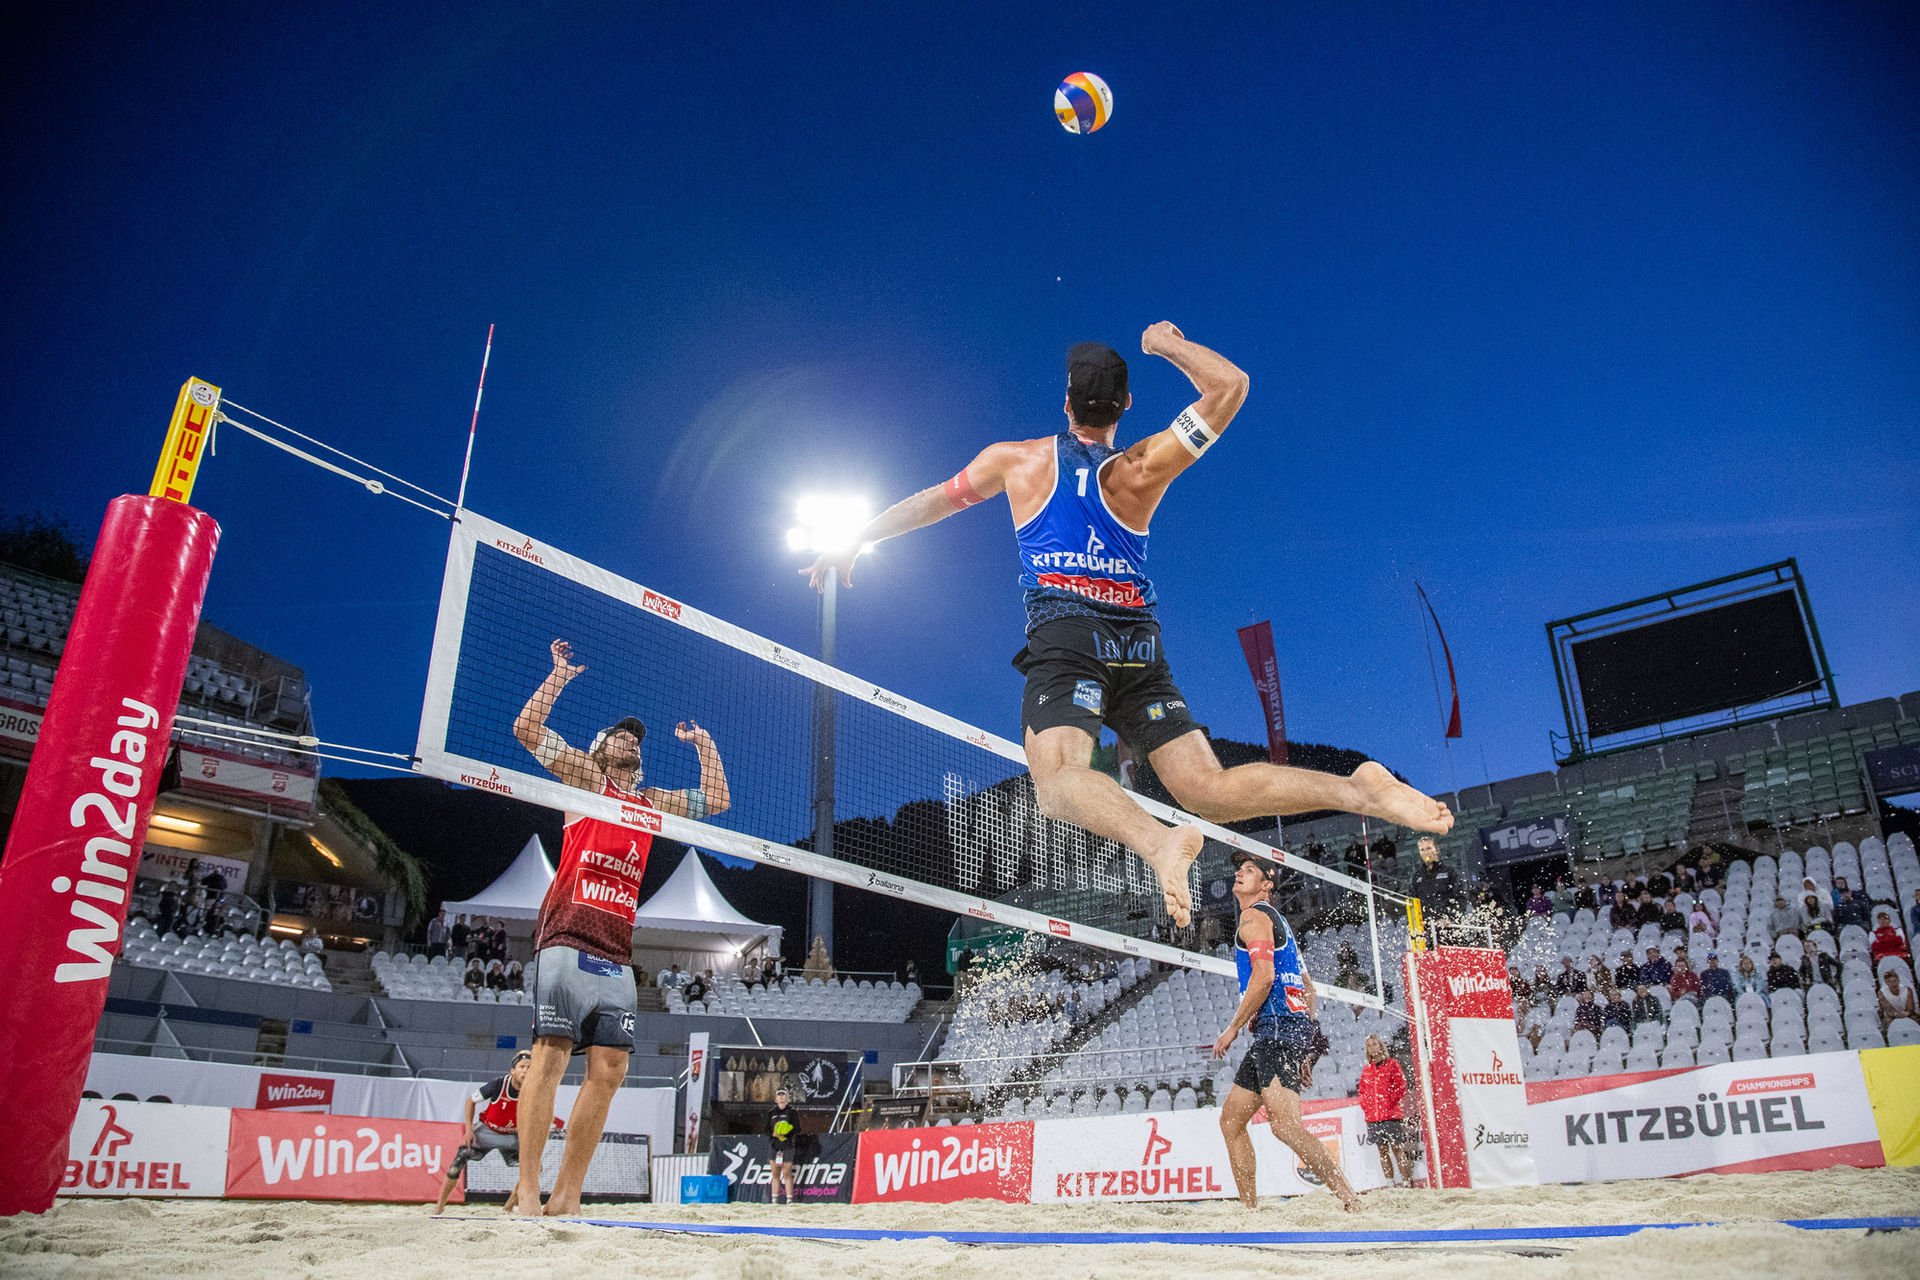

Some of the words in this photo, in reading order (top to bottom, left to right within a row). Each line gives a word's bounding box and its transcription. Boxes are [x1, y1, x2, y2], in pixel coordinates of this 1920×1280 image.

[1176, 417, 1191, 433] HYP
[1181, 411, 1196, 428] NOE
[1075, 468, 1088, 497] 1
[0, 713, 39, 736] GROS
[51, 697, 159, 983] win2day
[155, 853, 242, 879] INTESPORT
[1449, 972, 1508, 997] win2day
[268, 1083, 325, 1101] win2day
[1736, 1076, 1810, 1092] CHAMPIONSHIPS
[1565, 1091, 1825, 1147] KITZBÜHEL
[1486, 1130, 1529, 1145] ballarina
[258, 1125, 441, 1185] win2day
[874, 1136, 1013, 1195] win2day
[61, 1160, 191, 1190] BÜHEL
[741, 1157, 847, 1185] baarina
